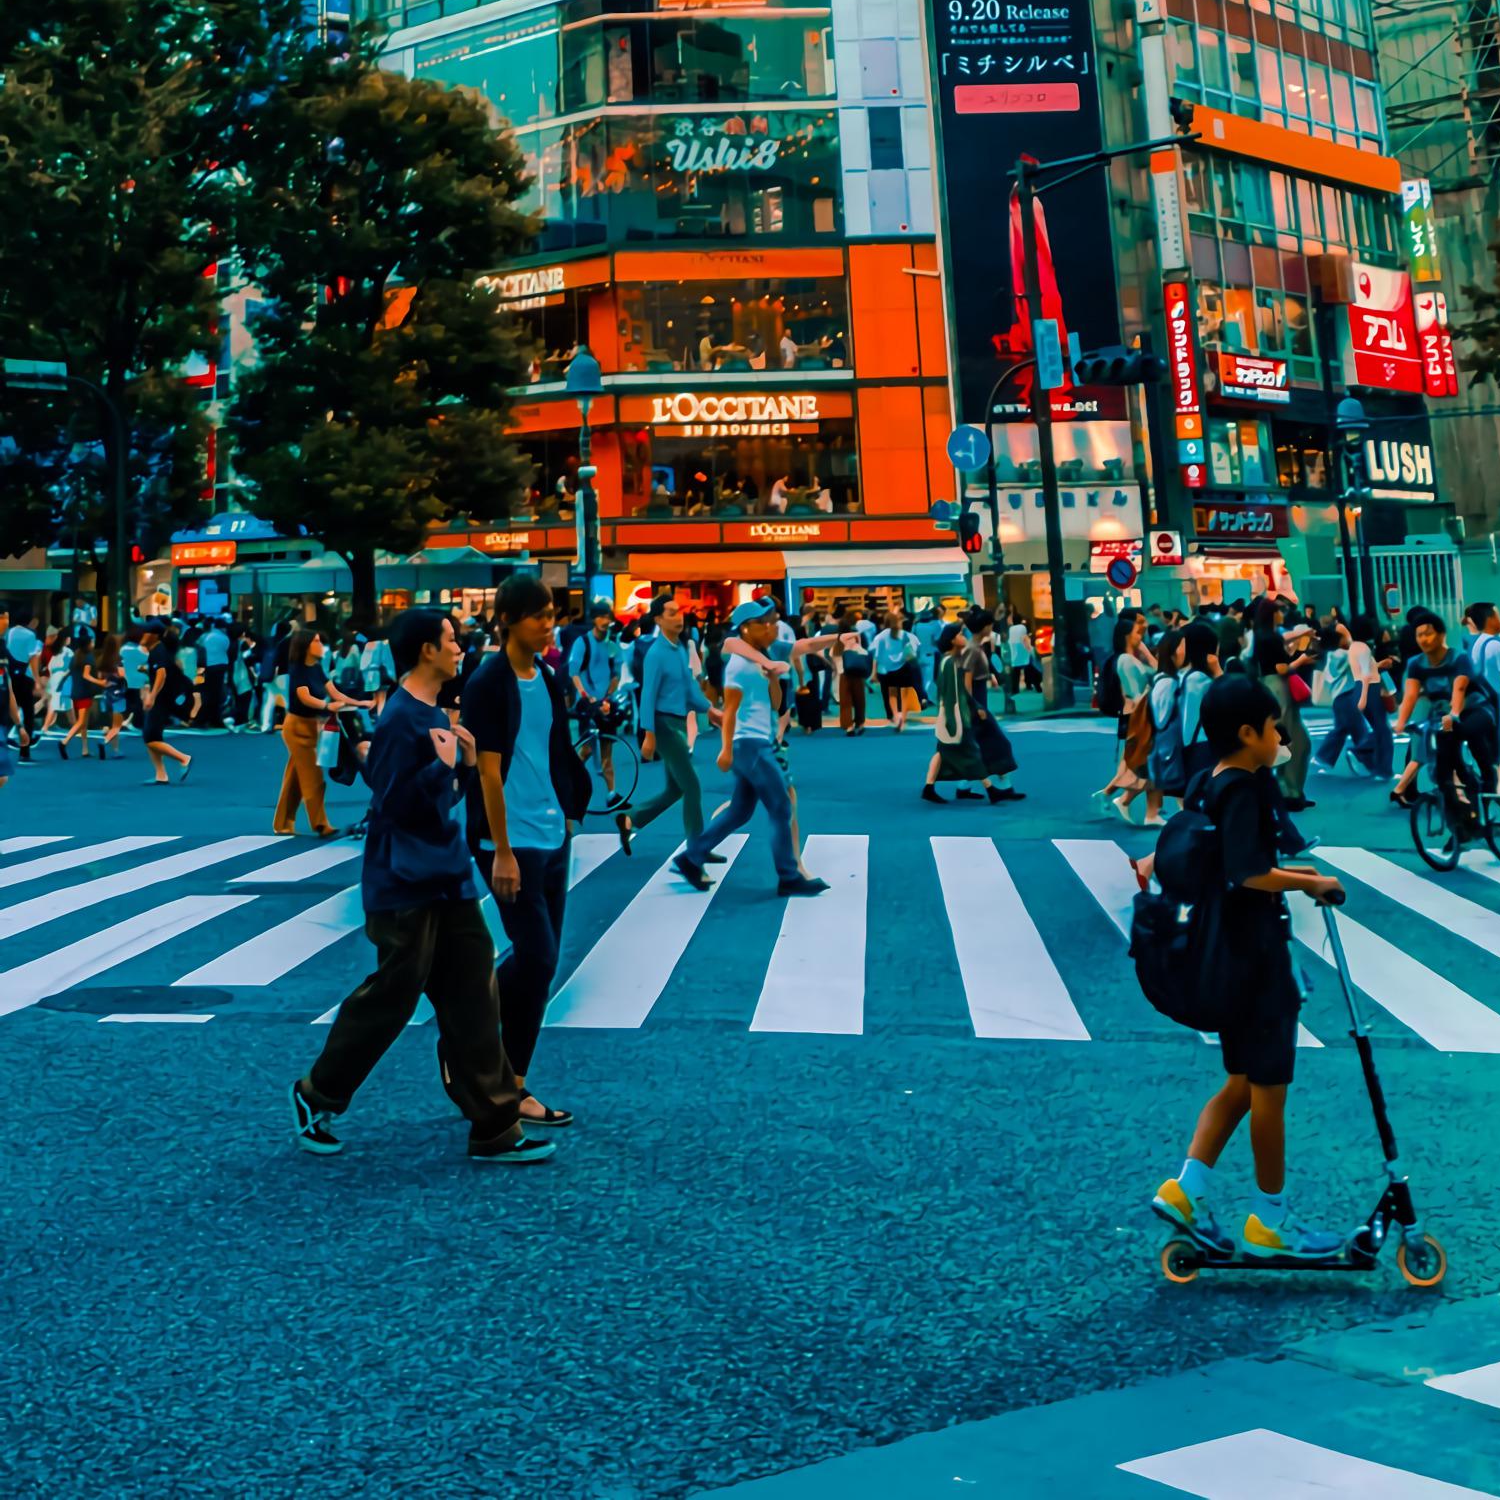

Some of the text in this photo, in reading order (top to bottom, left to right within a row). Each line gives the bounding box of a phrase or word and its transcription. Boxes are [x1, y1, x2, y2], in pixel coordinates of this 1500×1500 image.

[1006, 3, 1070, 20] Release
[652, 393, 819, 424] L'OCCITANE
[1366, 439, 1434, 486] LUSH
